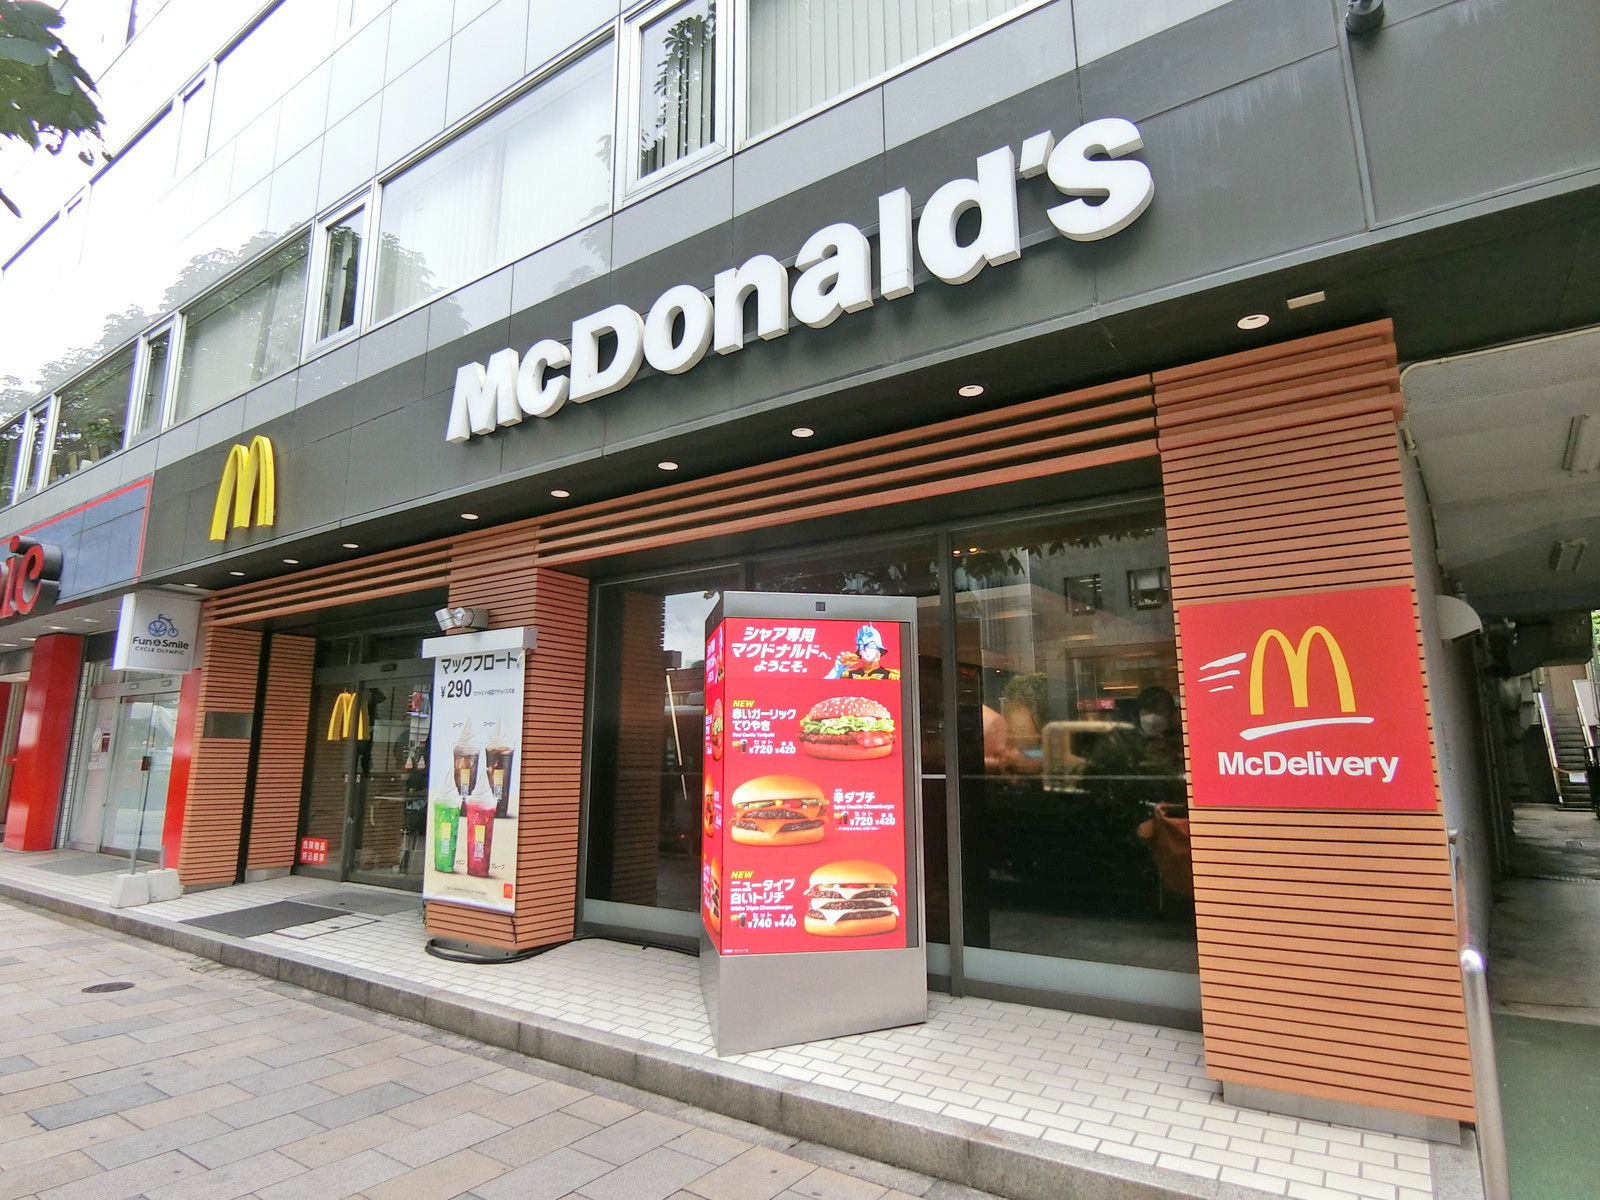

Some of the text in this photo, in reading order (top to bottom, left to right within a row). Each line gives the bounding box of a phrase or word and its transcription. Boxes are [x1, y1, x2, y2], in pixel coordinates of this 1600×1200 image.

[446, 117, 1155, 444] McDonald's
[743, 626, 817, 643] シャア専用
[132, 636, 152, 646] Fun
[162, 639, 190, 650] Smile
[157, 647, 185, 655] OLYMPIC
[440, 679, 472, 699] ¥290
[732, 699, 755, 708] NEW
[732, 708, 797, 720] 赤いガーリック
[732, 720, 771, 731] てりやき
[748, 745, 773, 754] ¥720
[1217, 750, 1399, 783] McDelivery
[850, 817, 873, 826] ¥720
[730, 871, 754, 879] NEW
[730, 878, 796, 892] ニュータイプ
[730, 891, 785, 905] 白いトリチ
[747, 918, 772, 928] ¥740
